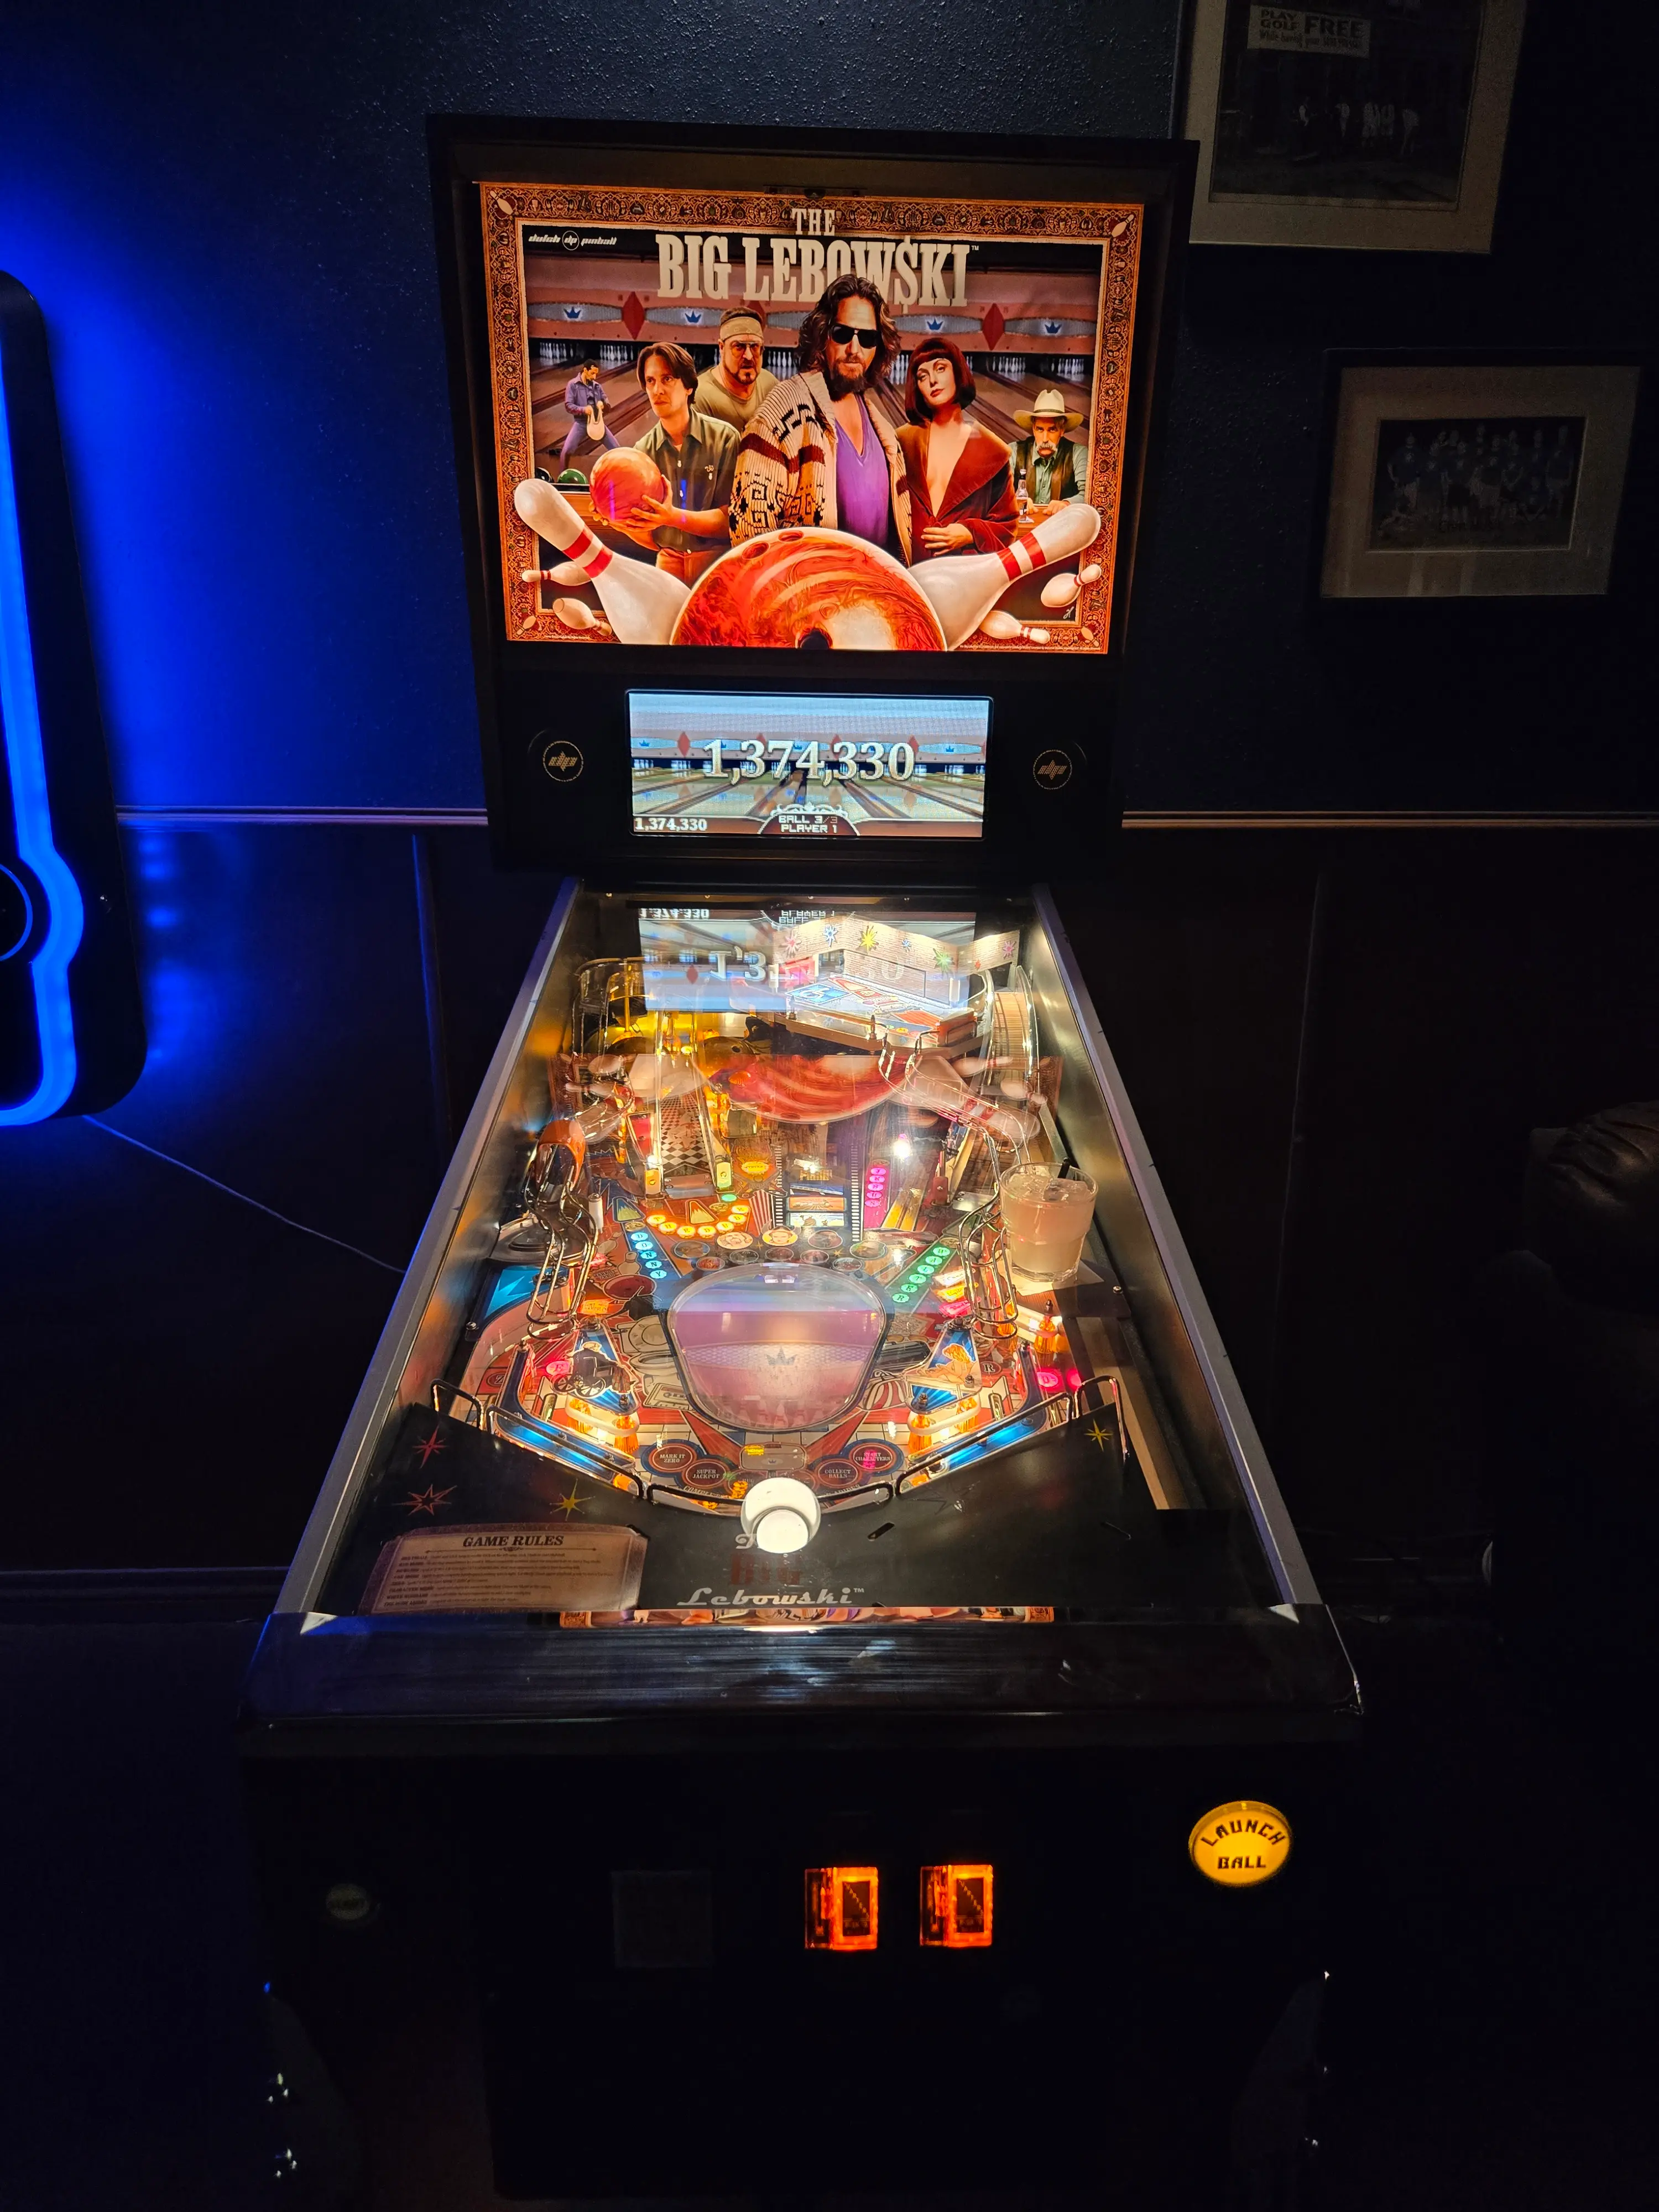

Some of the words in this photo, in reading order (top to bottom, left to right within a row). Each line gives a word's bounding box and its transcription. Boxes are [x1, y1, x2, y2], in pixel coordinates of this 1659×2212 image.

[1261, 9, 1297, 21] PLAY
[1261, 19, 1300, 31] GOLF
[1304, 15, 1365, 38] FREE
[791, 208, 835, 236] THE
[581, 237, 617, 247] pinball
[655, 234, 732, 300] BIG
[703, 739, 915, 786] 1,374,330
[635, 817, 708, 831] 1,374,330
[779, 815, 811, 824] BALL
[781, 823, 828, 833] PLAYER
[832, 824, 838, 833] 1
[983, 1363, 995, 1373] R
[463, 1536, 509, 1547] GAME
[511, 1535, 564, 1546] RULES
[676, 1587, 853, 1606] Lebowski
[1200, 1818, 1286, 1847] LAUNCH
[1217, 1855, 1267, 1870] BALL
